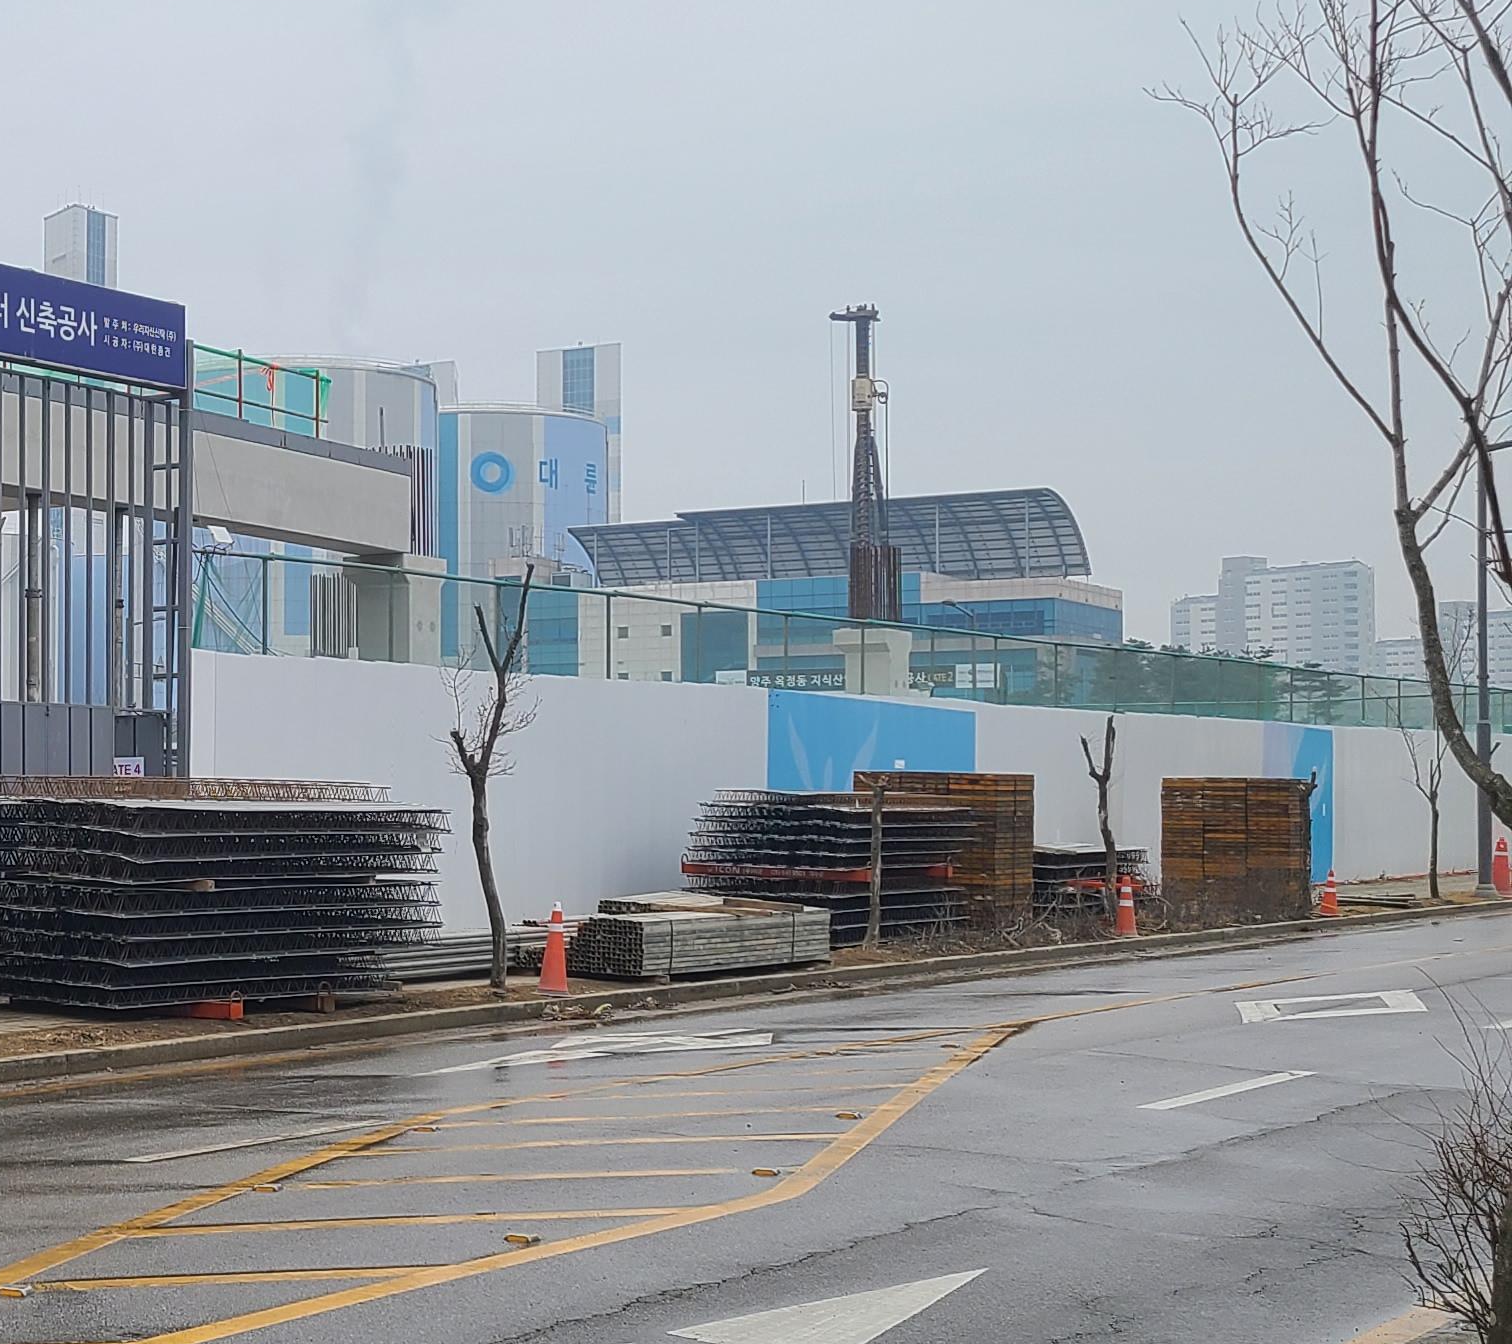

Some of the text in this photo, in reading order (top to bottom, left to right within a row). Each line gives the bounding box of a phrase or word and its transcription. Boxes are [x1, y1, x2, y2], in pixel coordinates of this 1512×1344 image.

[15, 297, 98, 347] 신축공사
[810, 673, 846, 687] 지식산
[113, 763, 142, 776] ATE 4
